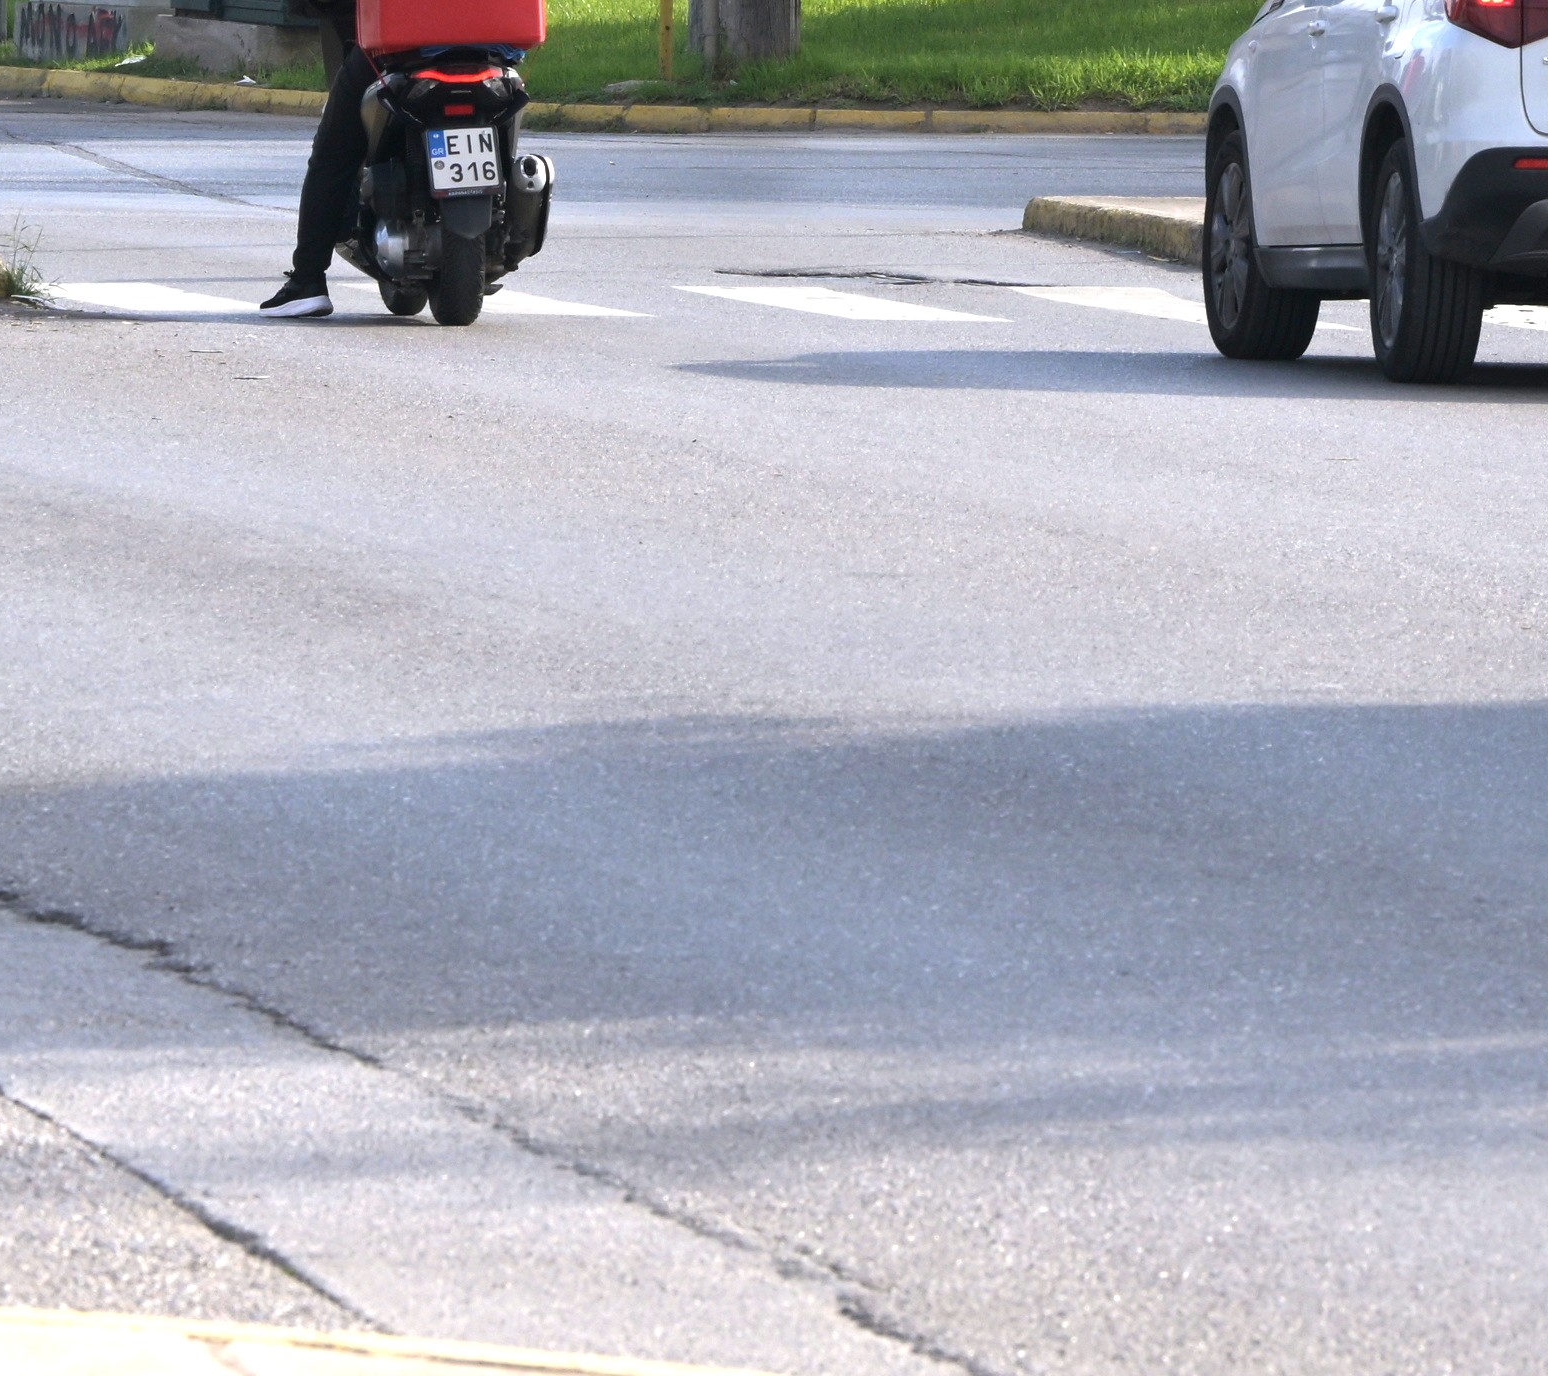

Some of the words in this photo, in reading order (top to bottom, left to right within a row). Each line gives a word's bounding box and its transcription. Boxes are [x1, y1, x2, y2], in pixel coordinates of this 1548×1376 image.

[431, 148, 445, 156] GR
[446, 133, 493, 156] EIN
[450, 161, 496, 183] 316
